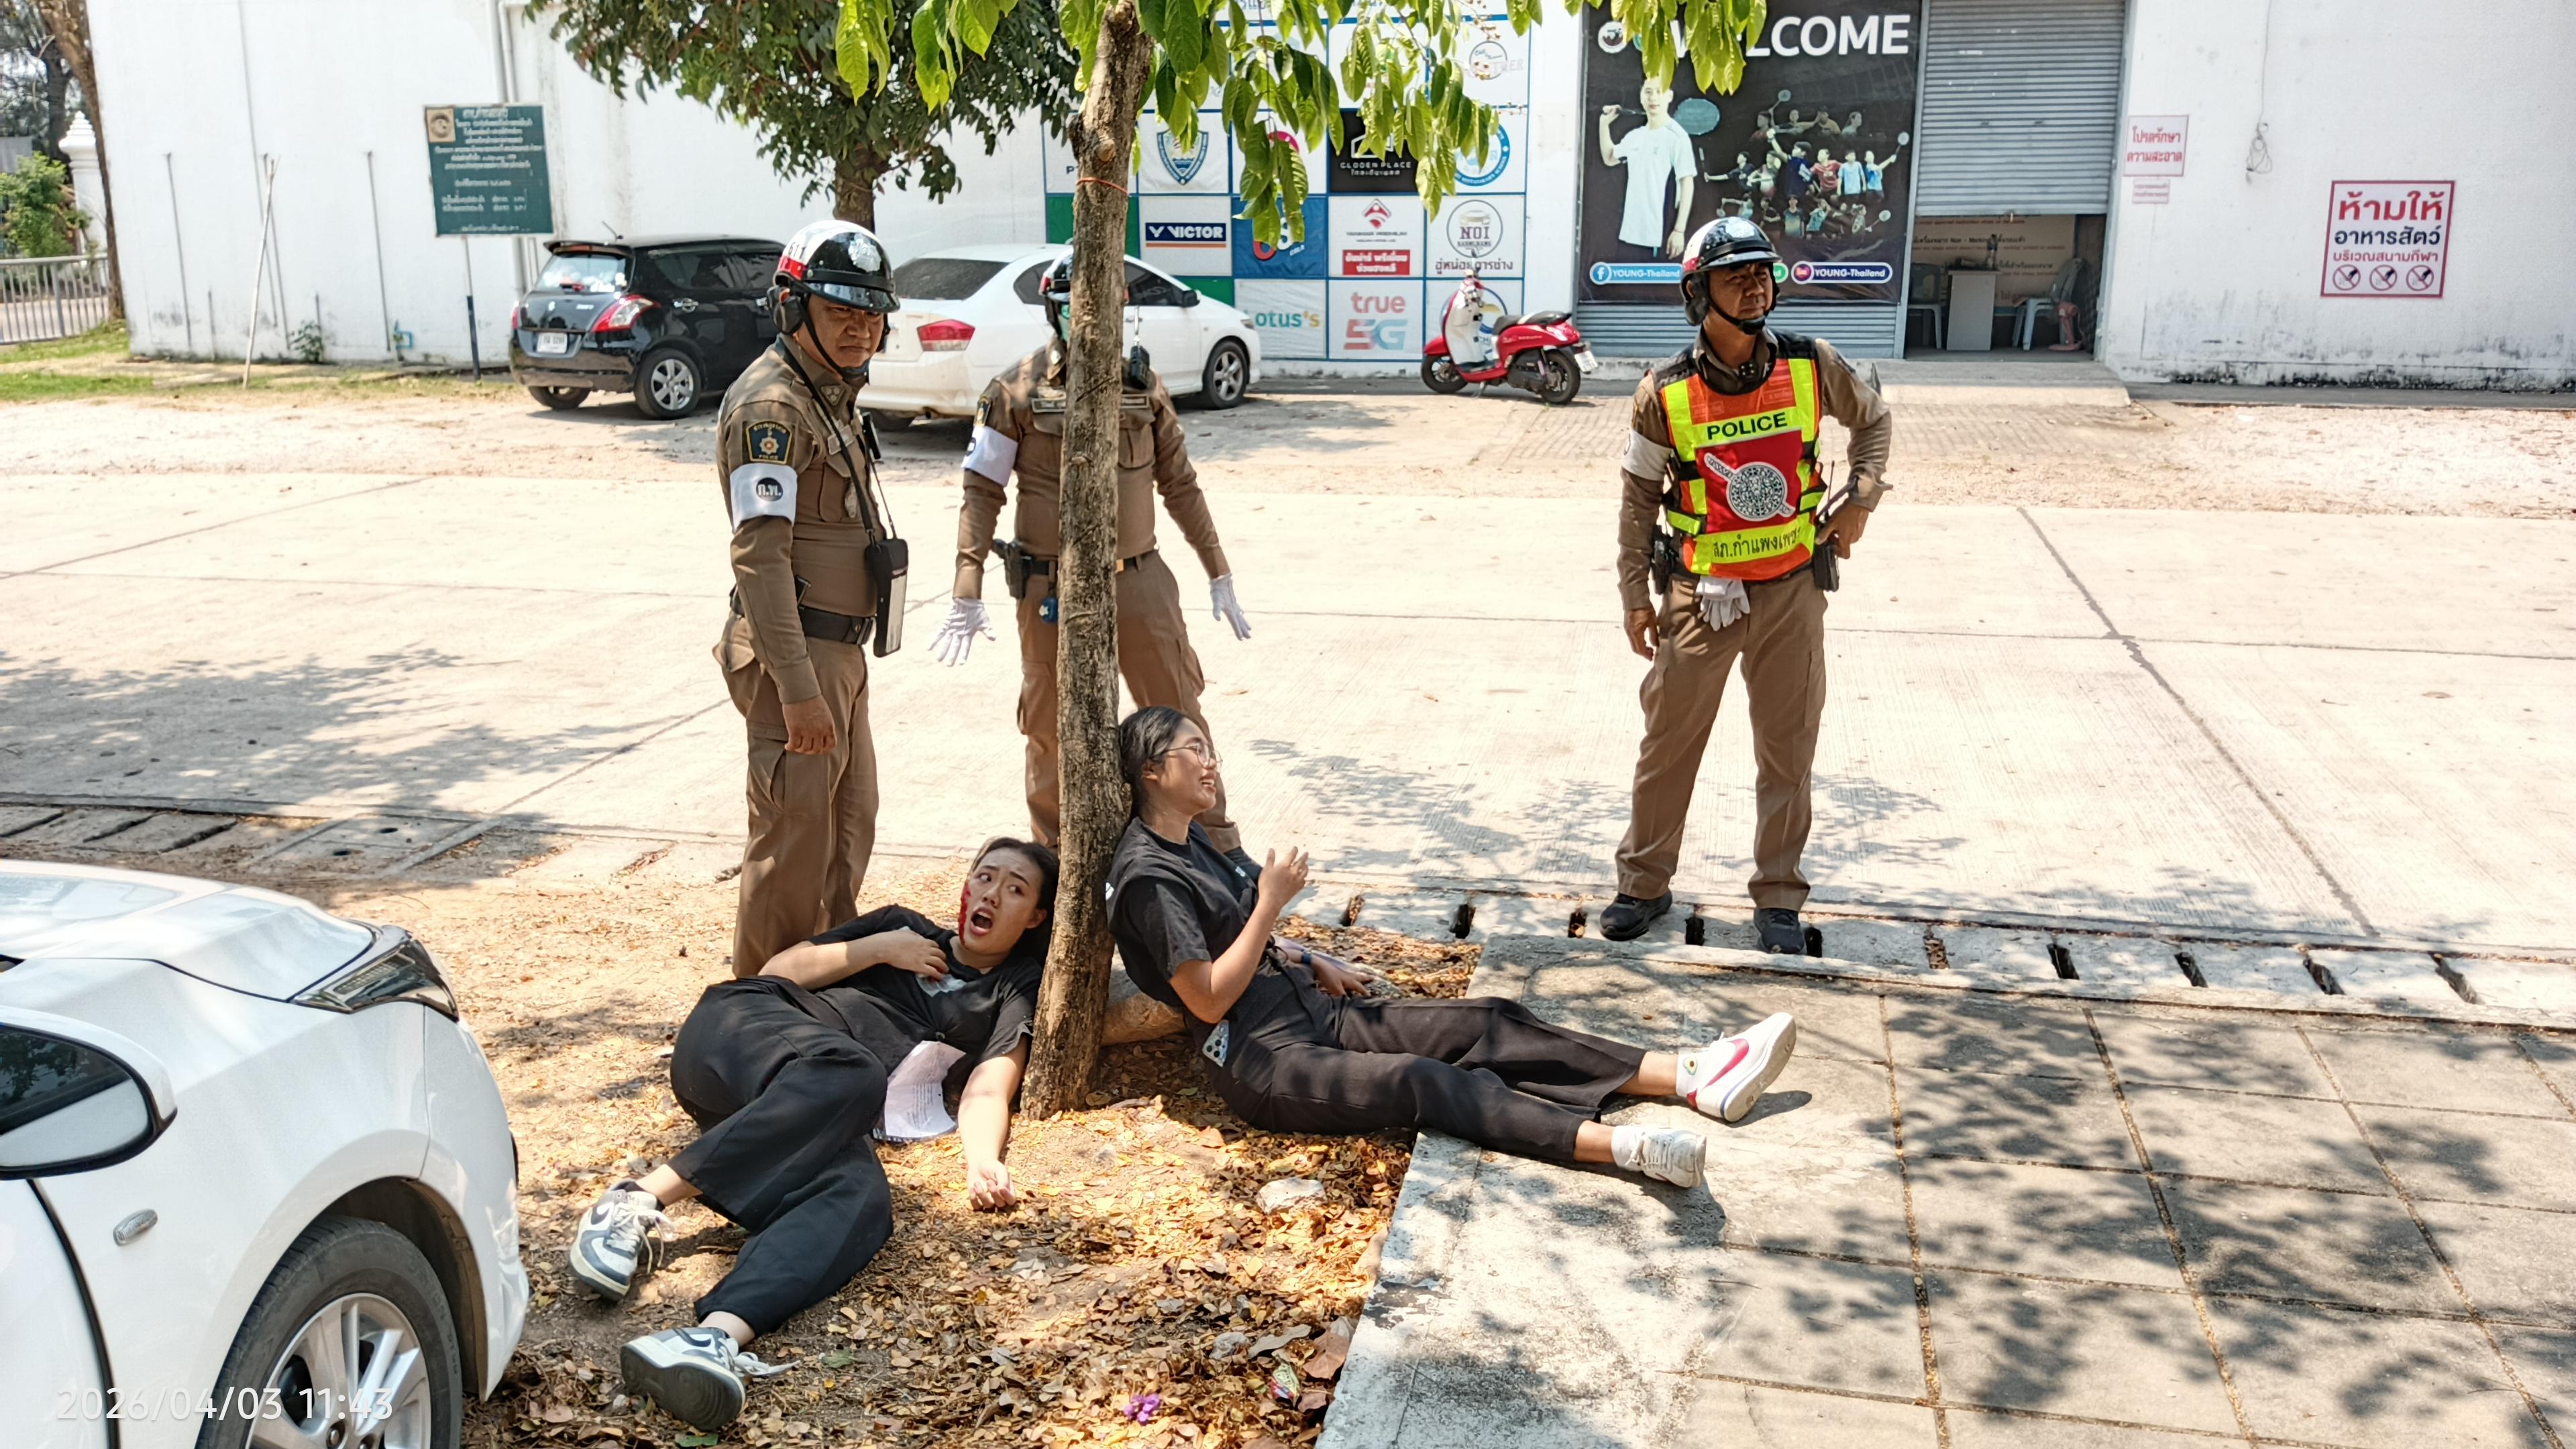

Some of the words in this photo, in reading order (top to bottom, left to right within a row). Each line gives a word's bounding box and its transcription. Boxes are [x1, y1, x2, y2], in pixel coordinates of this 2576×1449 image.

[2339, 191, 2445, 220] ห้ามให้
[1167, 225, 1223, 238] VICTOR
[1460, 226, 1490, 239] NOI
[2334, 225, 2442, 245] อาหารสัตว์
[2333, 249, 2438, 262] บริเวณสนามกีฬา
[1815, 268, 1886, 277] YOUNG-Thailand
[1351, 292, 1406, 313] true
[1254, 310, 1321, 328] otus's
[1344, 319, 1408, 350] 5G
[1707, 412, 1788, 440] POLICE
